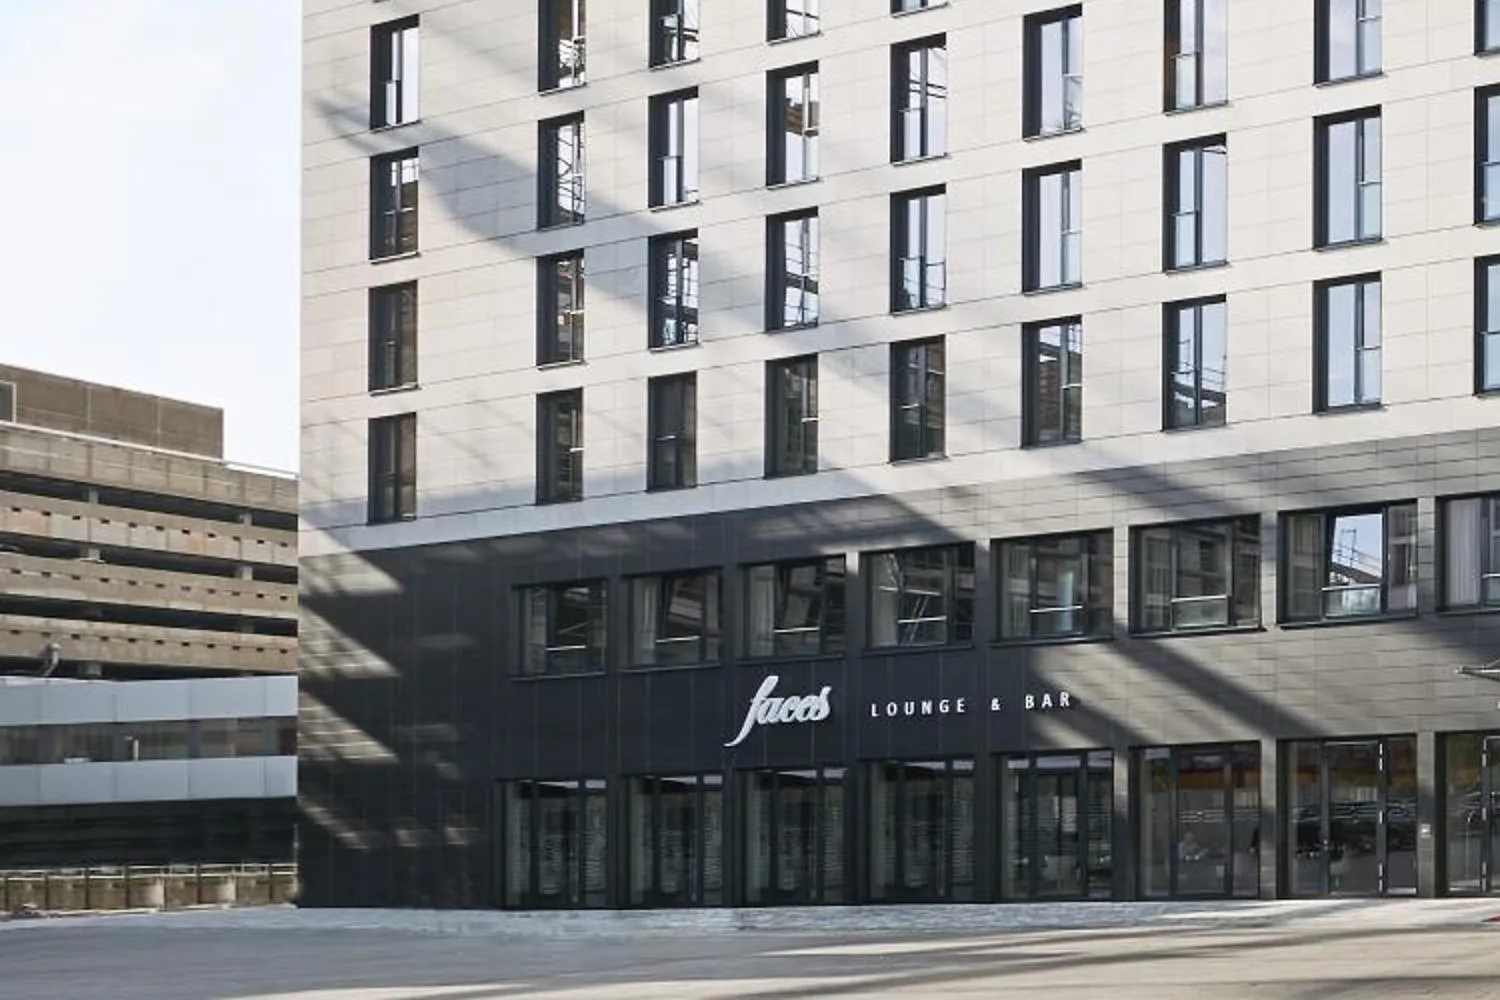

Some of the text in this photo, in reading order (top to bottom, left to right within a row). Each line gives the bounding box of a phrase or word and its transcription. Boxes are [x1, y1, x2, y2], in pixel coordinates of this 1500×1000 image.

[871, 697, 966, 718] LOUNGE
[990, 697, 1001, 711] &
[1025, 691, 1071, 710] BAR
